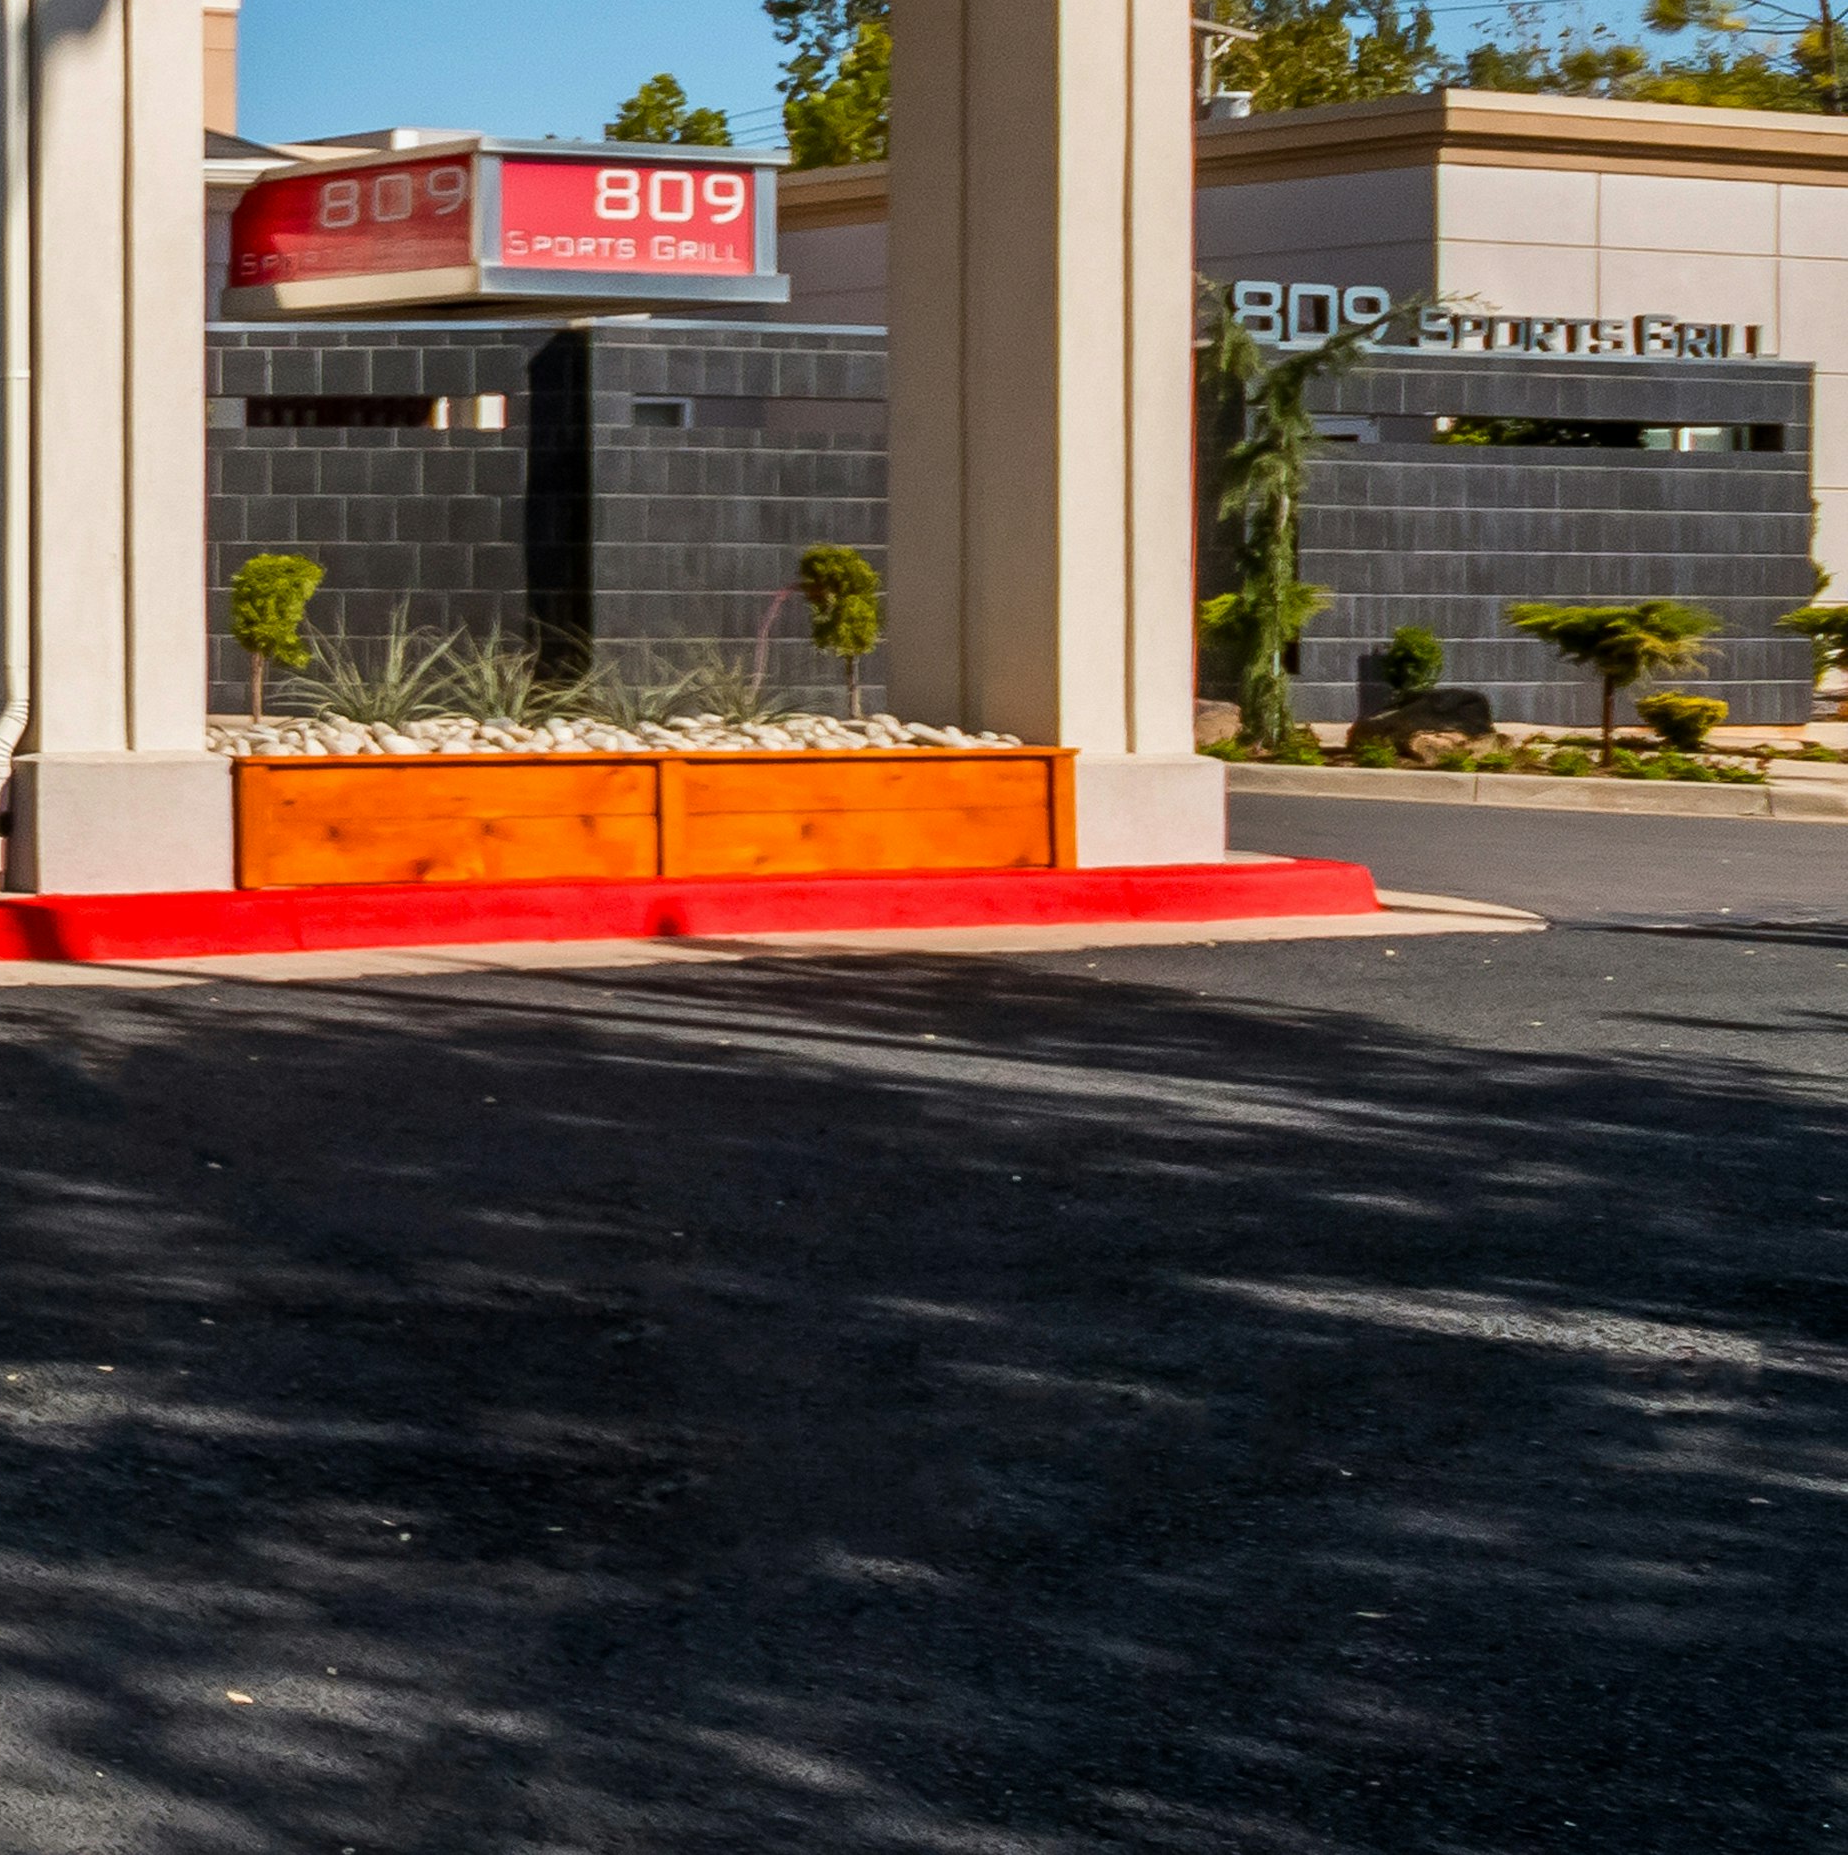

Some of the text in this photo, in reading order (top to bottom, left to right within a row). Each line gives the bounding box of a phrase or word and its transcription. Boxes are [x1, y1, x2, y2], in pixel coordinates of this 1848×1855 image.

[318, 165, 468, 230] 809
[595, 168, 745, 225] 809
[1233, 279, 1391, 349] 809
